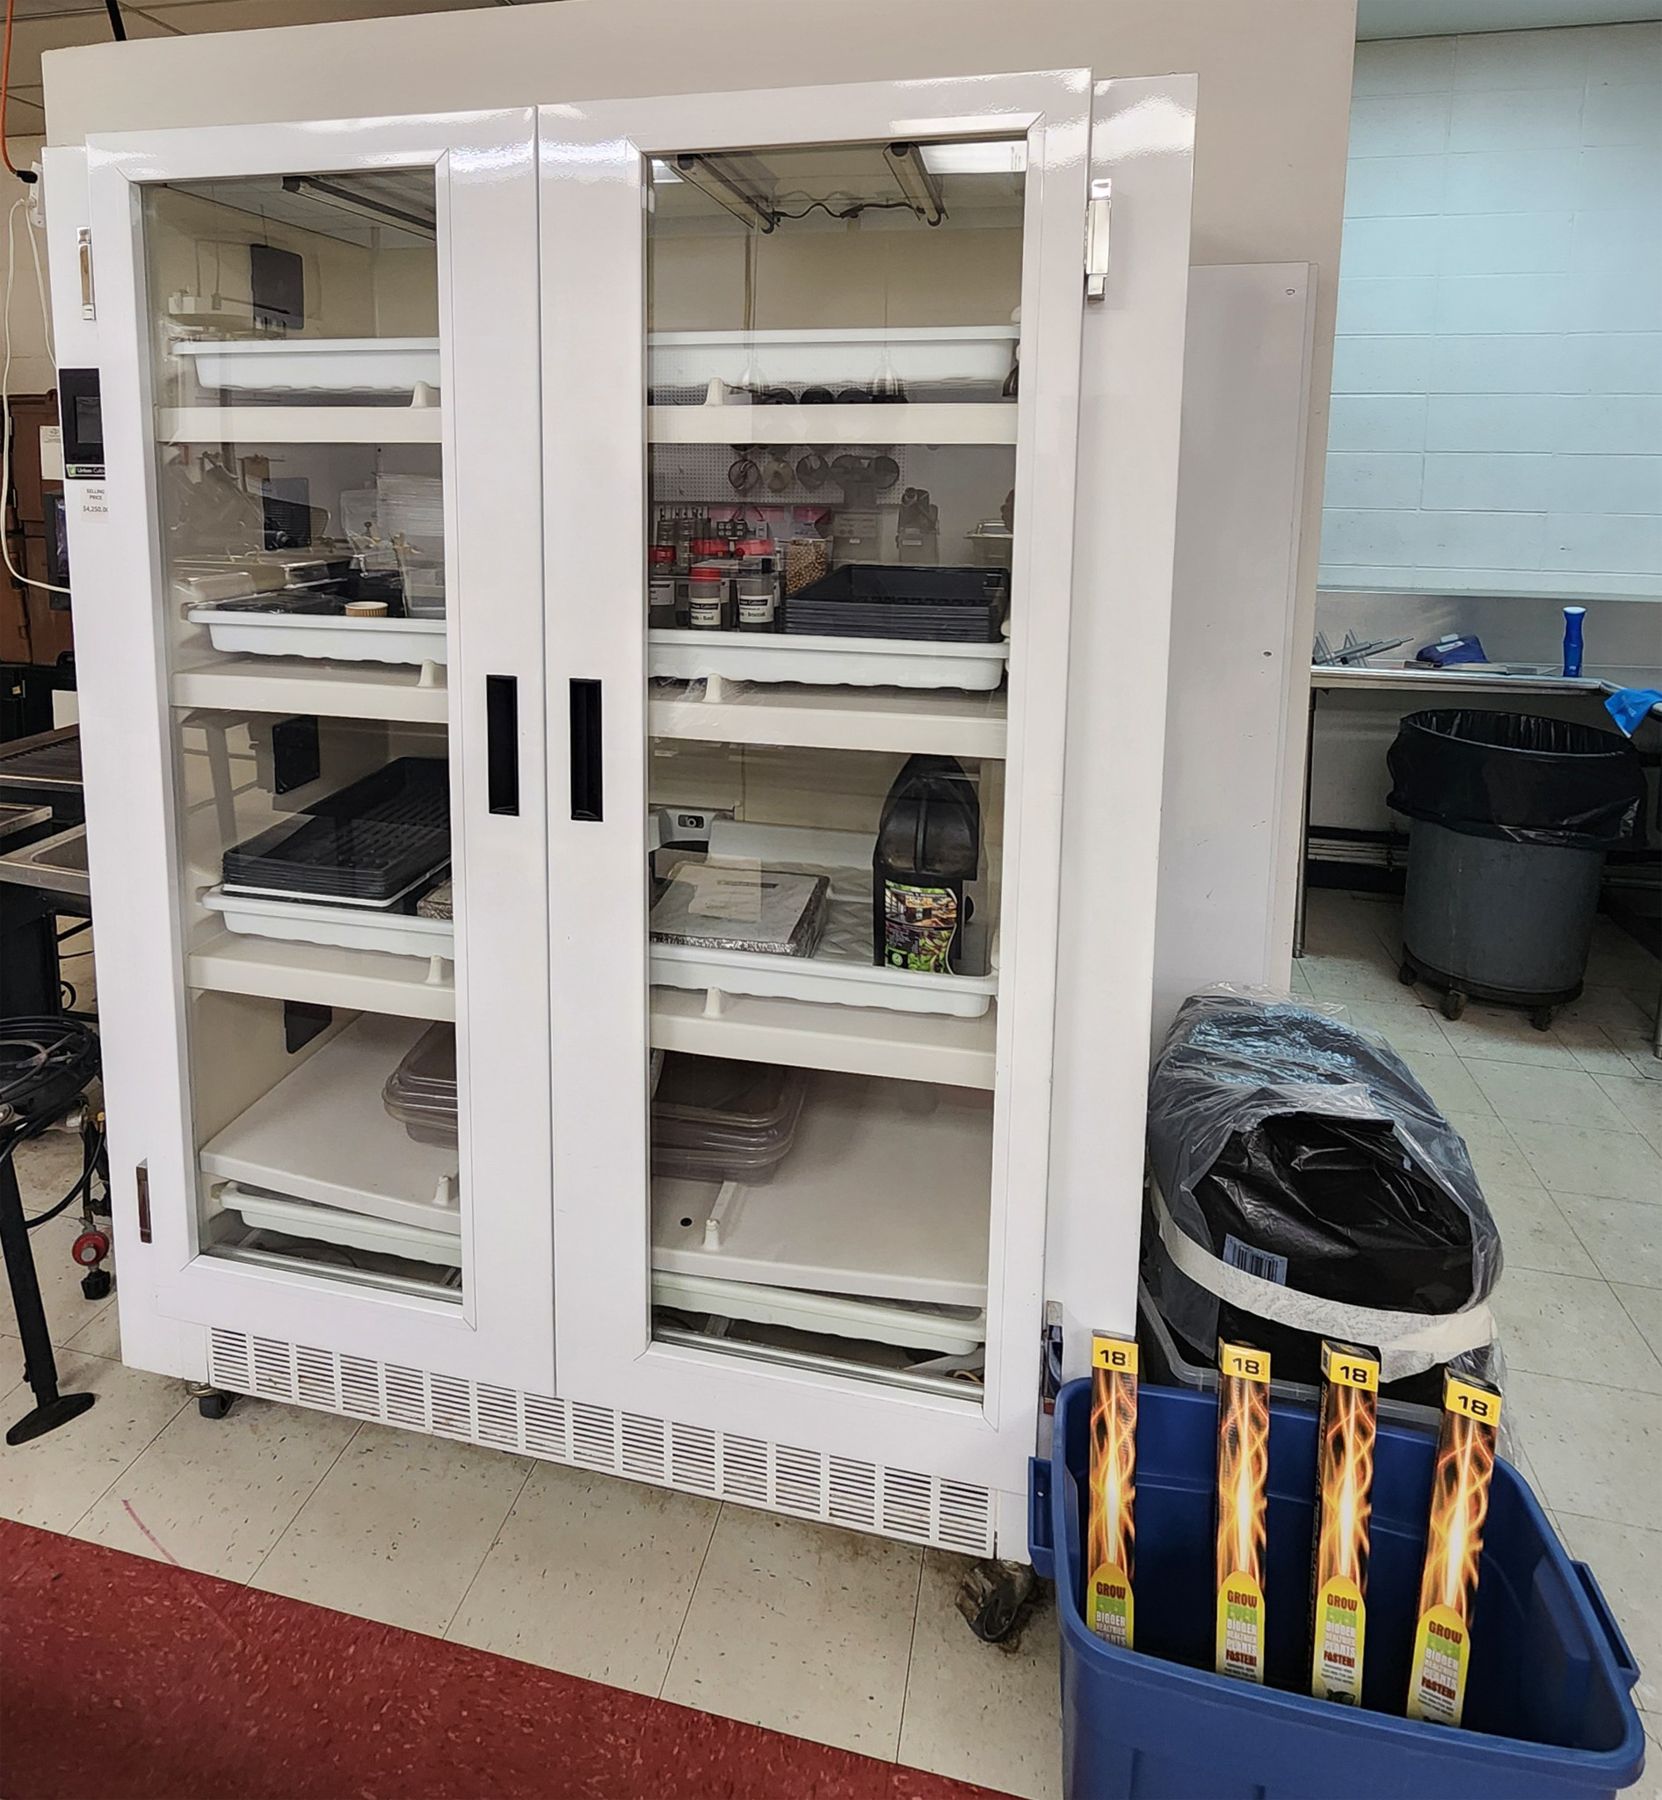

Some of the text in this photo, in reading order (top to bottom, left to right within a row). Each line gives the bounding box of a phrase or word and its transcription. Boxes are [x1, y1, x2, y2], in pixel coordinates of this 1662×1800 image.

[1099, 1349, 1126, 1366] 18
[1232, 1357, 1260, 1375] 18
[1340, 1365, 1368, 1384] 18
[1457, 1395, 1489, 1418] 18
[1096, 1581, 1126, 1600] GROW
[1227, 1589, 1258, 1609] GROW
[1327, 1593, 1358, 1612] GROW
[1096, 1610, 1126, 1627] BIGGER
[1428, 1620, 1463, 1645] GROW
[1324, 1650, 1355, 1668] FASTER!
